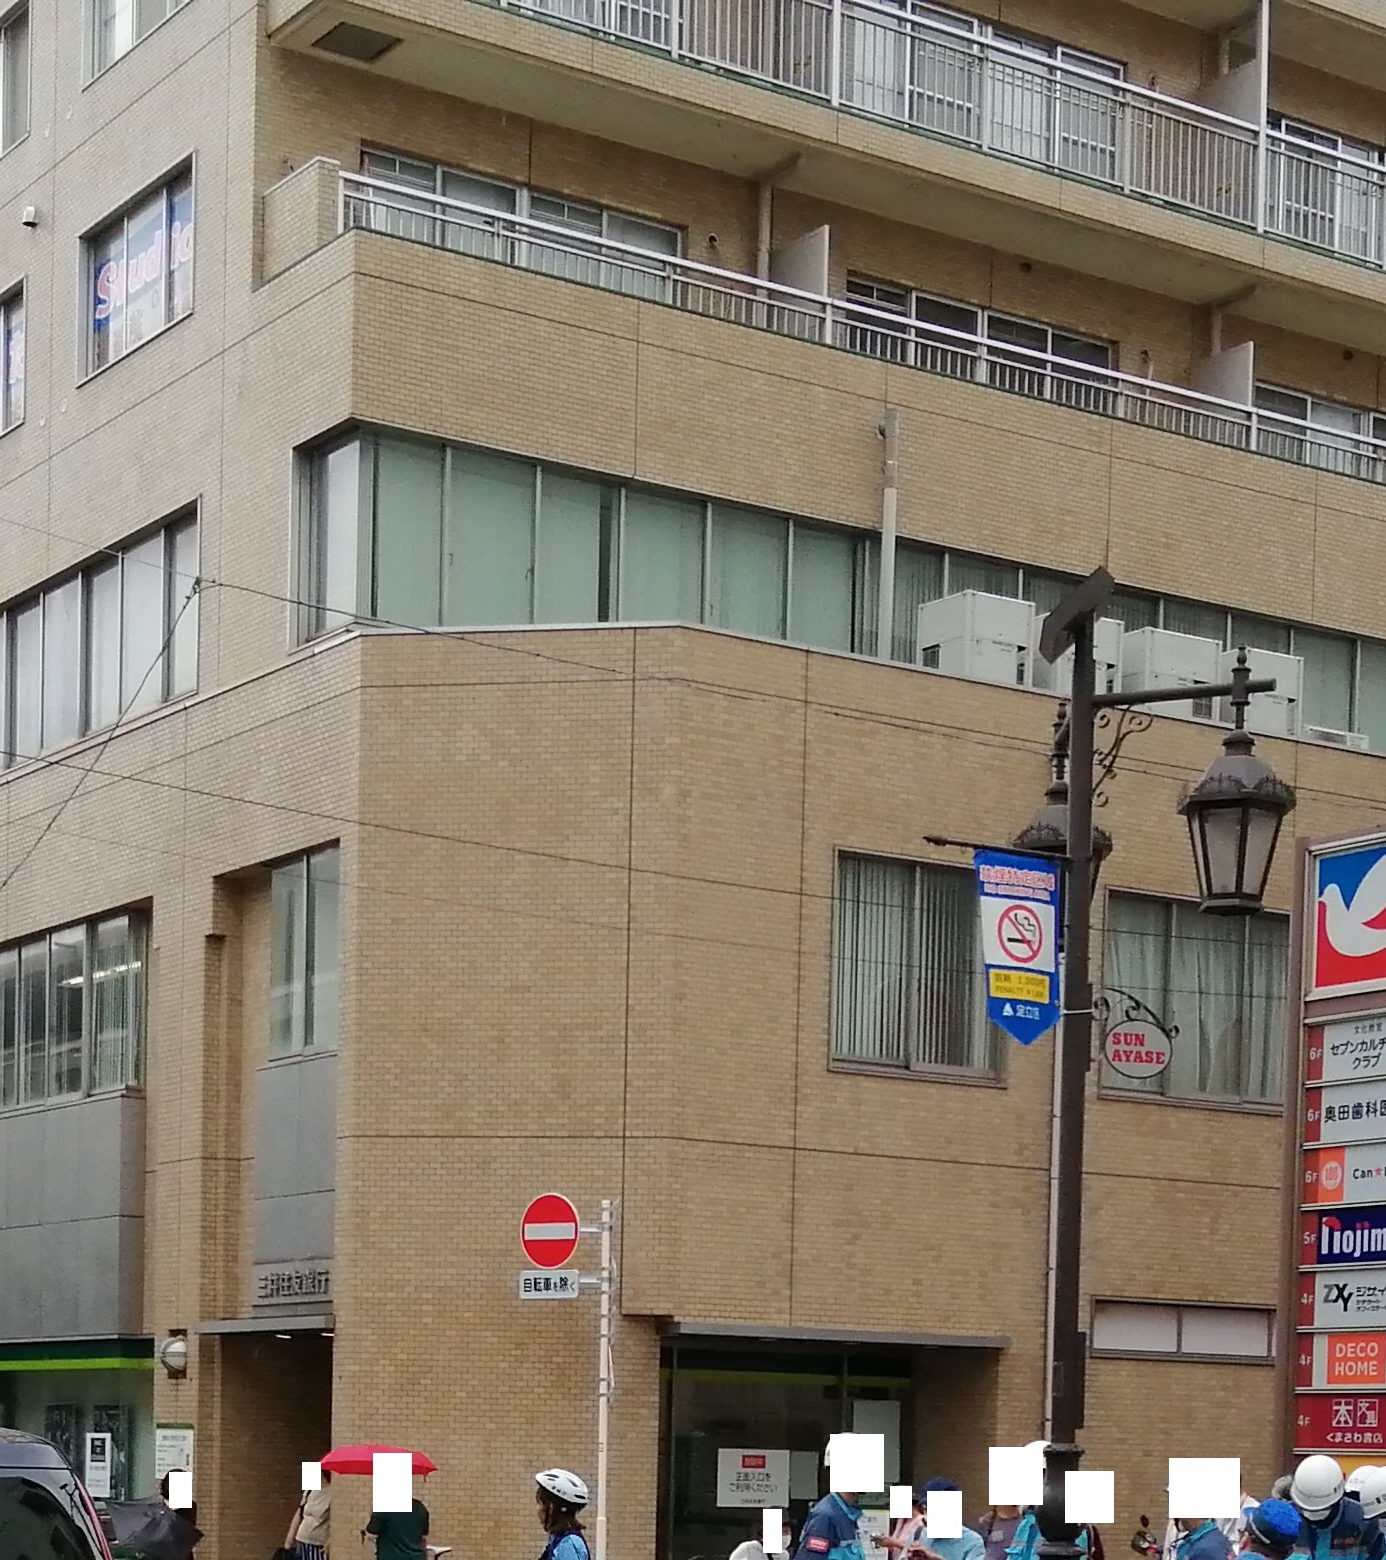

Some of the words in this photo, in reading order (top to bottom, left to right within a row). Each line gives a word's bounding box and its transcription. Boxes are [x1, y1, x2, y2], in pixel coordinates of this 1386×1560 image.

[1112, 1033, 1145, 1046] SUN
[1112, 1051, 1165, 1066] AYASE
[1309, 1048, 1322, 1060] 6F
[1352, 1053, 1381, 1070] クラブ
[1308, 1109, 1320, 1122] 6F
[1305, 1170, 1318, 1183] 6F
[1303, 1231, 1316, 1244] 5F
[524, 1276, 575, 1293] 自転車を除く
[1301, 1293, 1314, 1304] 4F
[1323, 1283, 1354, 1312] ZXY
[1335, 1343, 1379, 1357] DECO
[1299, 1354, 1312, 1365] 4F
[1335, 1361, 1378, 1376] HOME
[1297, 1415, 1310, 1426] 4F
[1326, 1432, 1383, 1443] くまさわ書店
